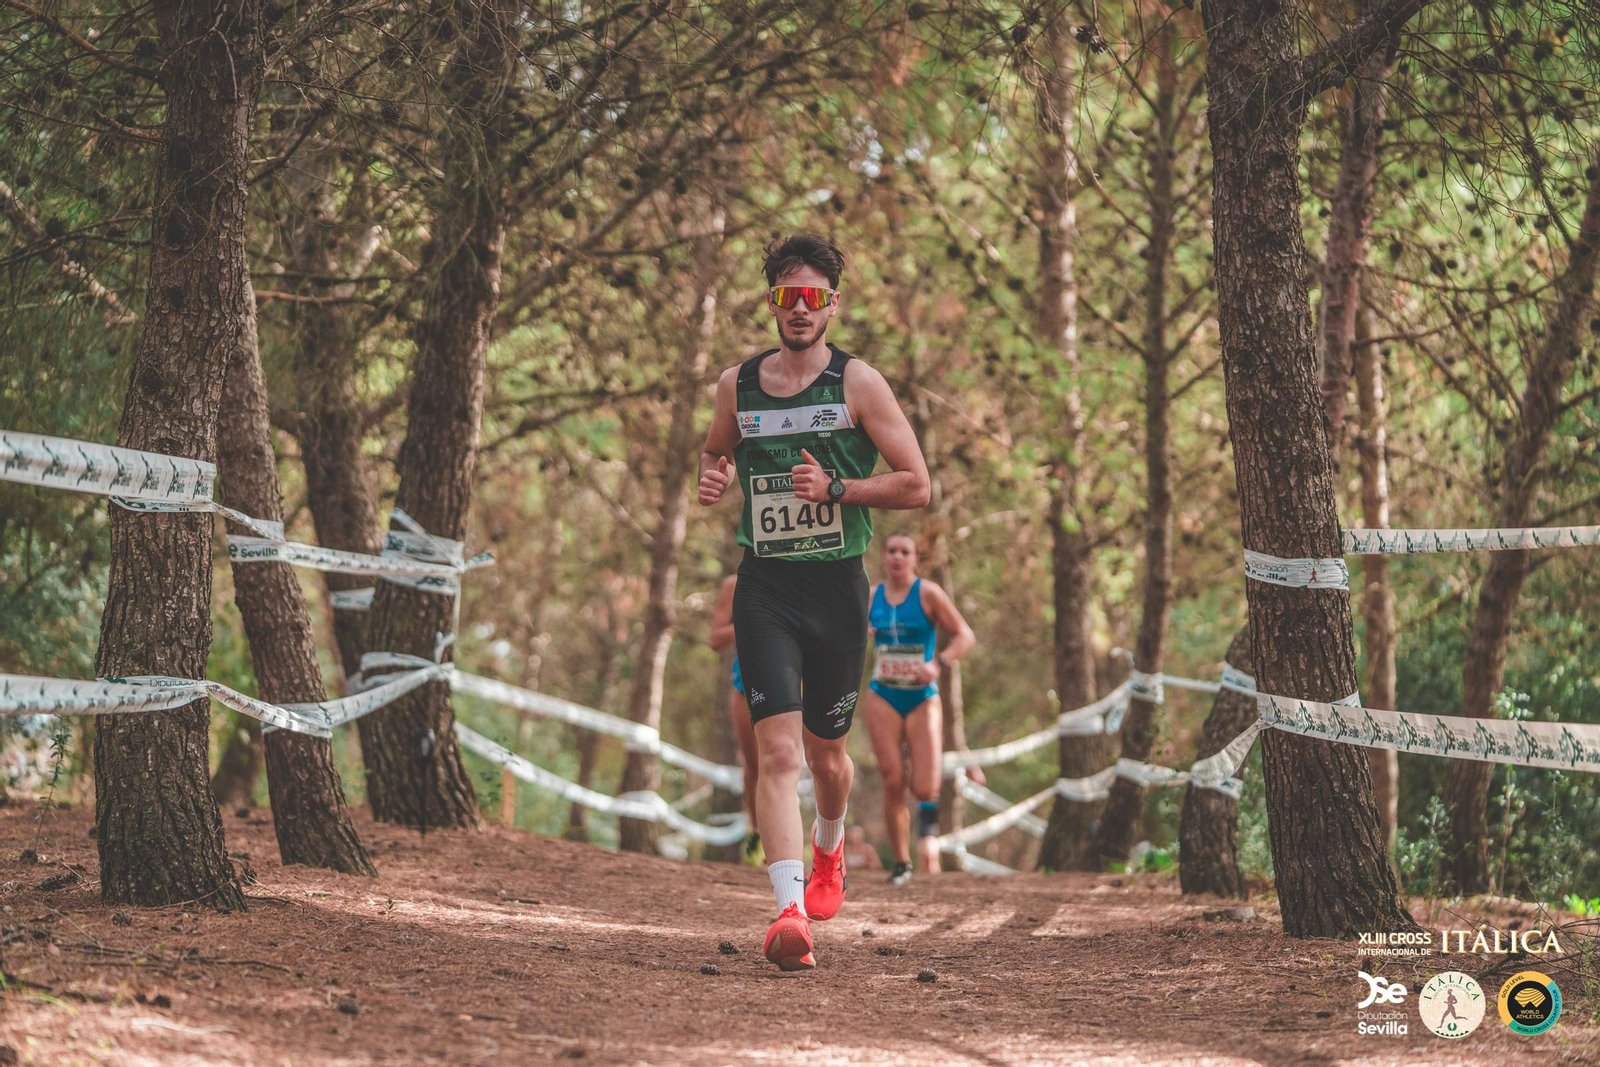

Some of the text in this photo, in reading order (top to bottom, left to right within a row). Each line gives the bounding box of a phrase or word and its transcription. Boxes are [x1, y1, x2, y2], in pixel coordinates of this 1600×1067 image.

[772, 476, 792, 487] ITÁL
[761, 502, 834, 533] 6140
[241, 548, 278, 558] Sevilla
